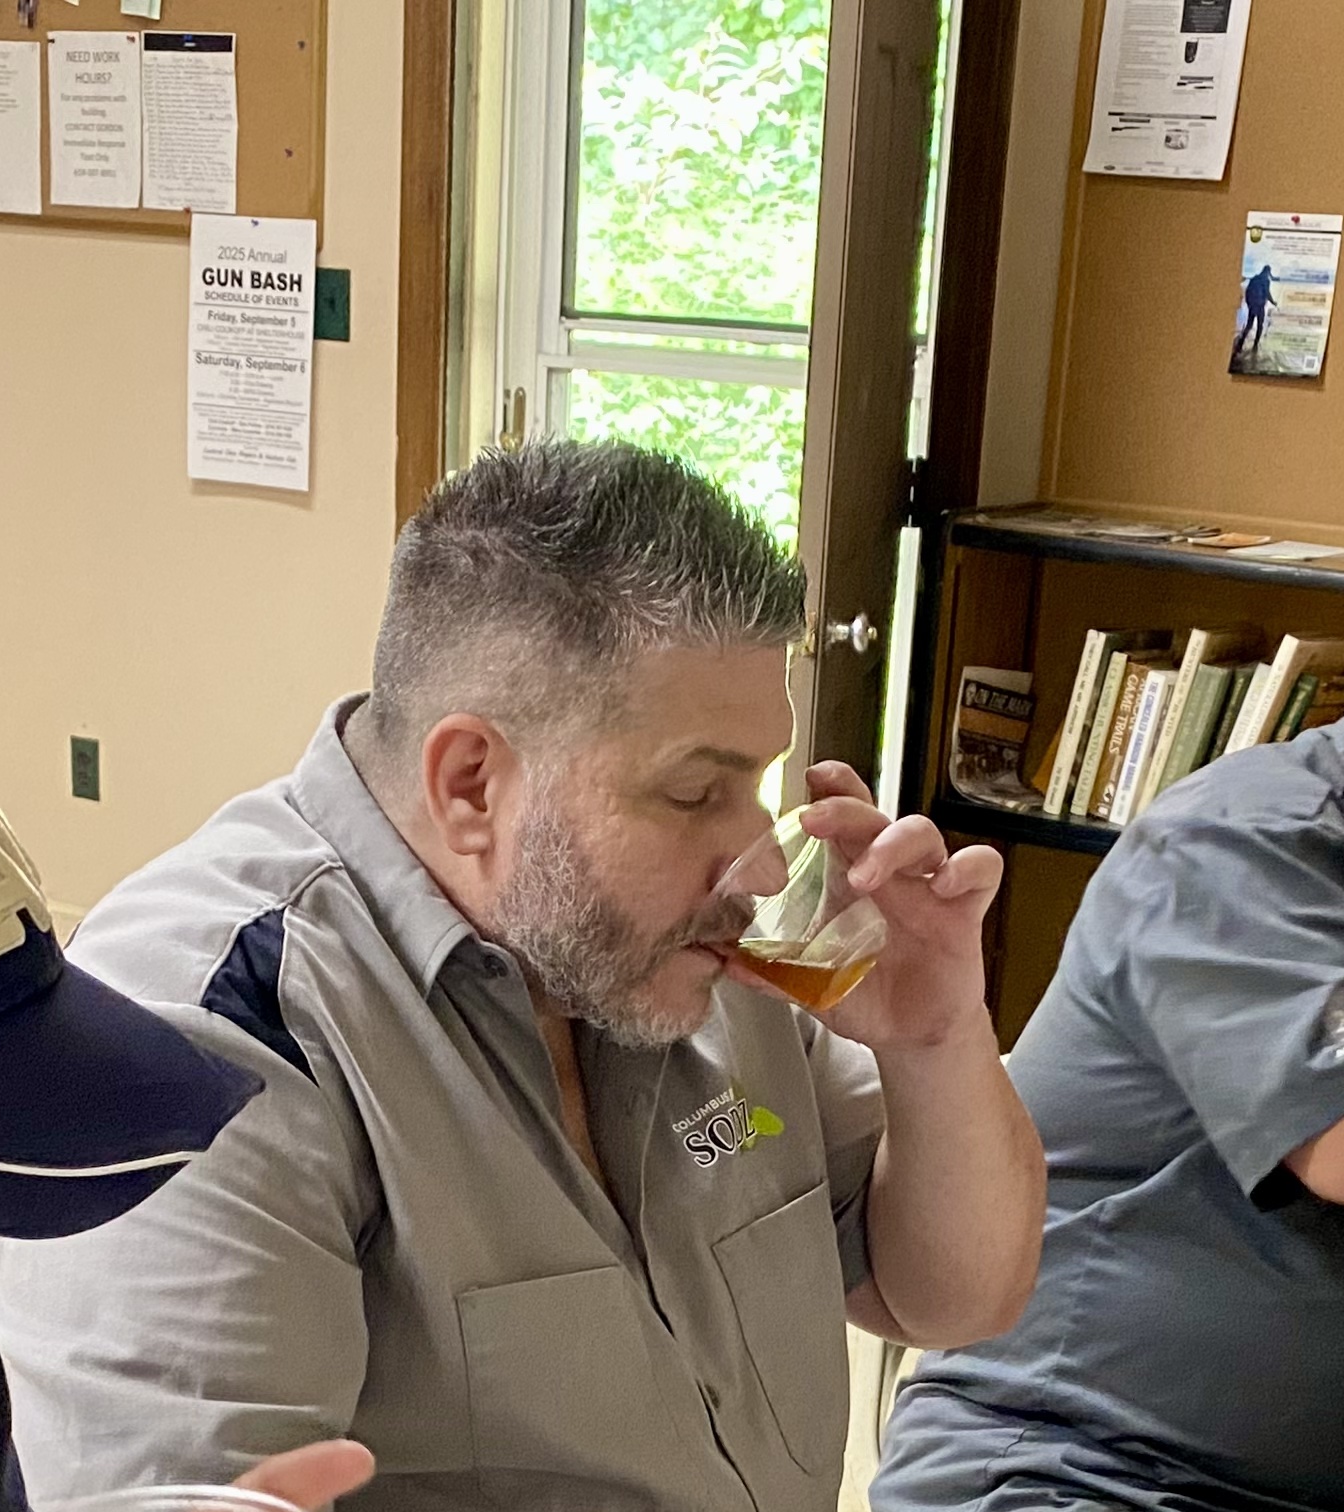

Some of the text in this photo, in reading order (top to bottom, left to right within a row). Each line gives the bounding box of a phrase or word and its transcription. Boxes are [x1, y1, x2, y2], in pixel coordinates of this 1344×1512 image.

[66, 51, 120, 63] NEED WORK
[75, 72, 113, 84] HOURS?
[217, 245, 287, 263] 2025 Annual
[202, 267, 302, 292] GUN BASH
[204, 290, 299, 307] SCHEDULE OF EVENTS
[208, 310, 238, 324] Friday,
[240, 313, 288, 326] September
[196, 352, 243, 369] Saturday,
[245, 356, 298, 372] September
[1120, 674, 1138, 715] GAME
[1148, 681, 1158, 693] THE
[1085, 714, 1107, 768] HUNTING
[1109, 714, 1128, 755] TRAILS
[672, 1091, 731, 1133] COLUMBUS
[683, 1098, 757, 1168] SODZ
